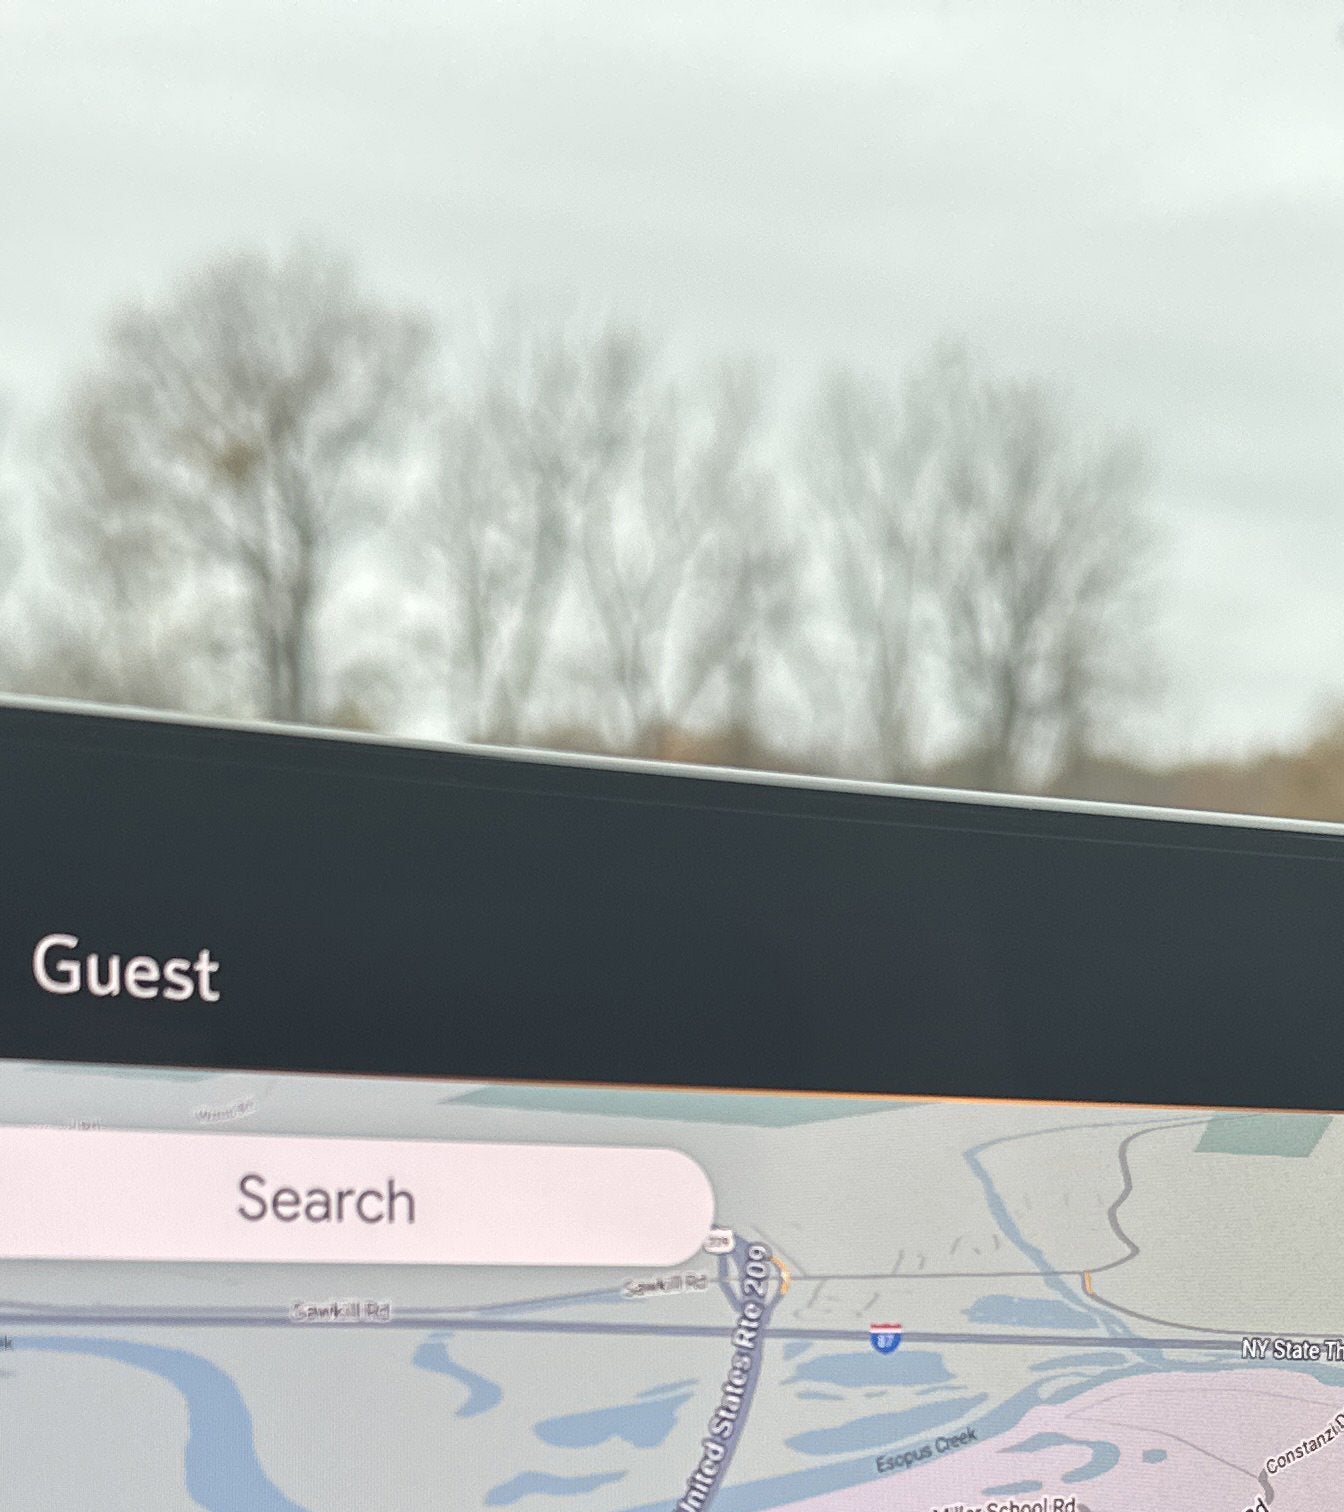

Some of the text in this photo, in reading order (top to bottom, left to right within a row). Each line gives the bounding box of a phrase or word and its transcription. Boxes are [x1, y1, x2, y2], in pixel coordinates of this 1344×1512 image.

[33, 932, 220, 1003] Guest
[237, 1174, 416, 1225] Search
[709, 1351, 752, 1440] States
[743, 1245, 768, 1297] 209
[1241, 1338, 1268, 1359] NY
[1273, 1341, 1319, 1361] State
[875, 1426, 977, 1473] Esopus Creek
[1266, 1422, 1341, 1475] Constanzi
